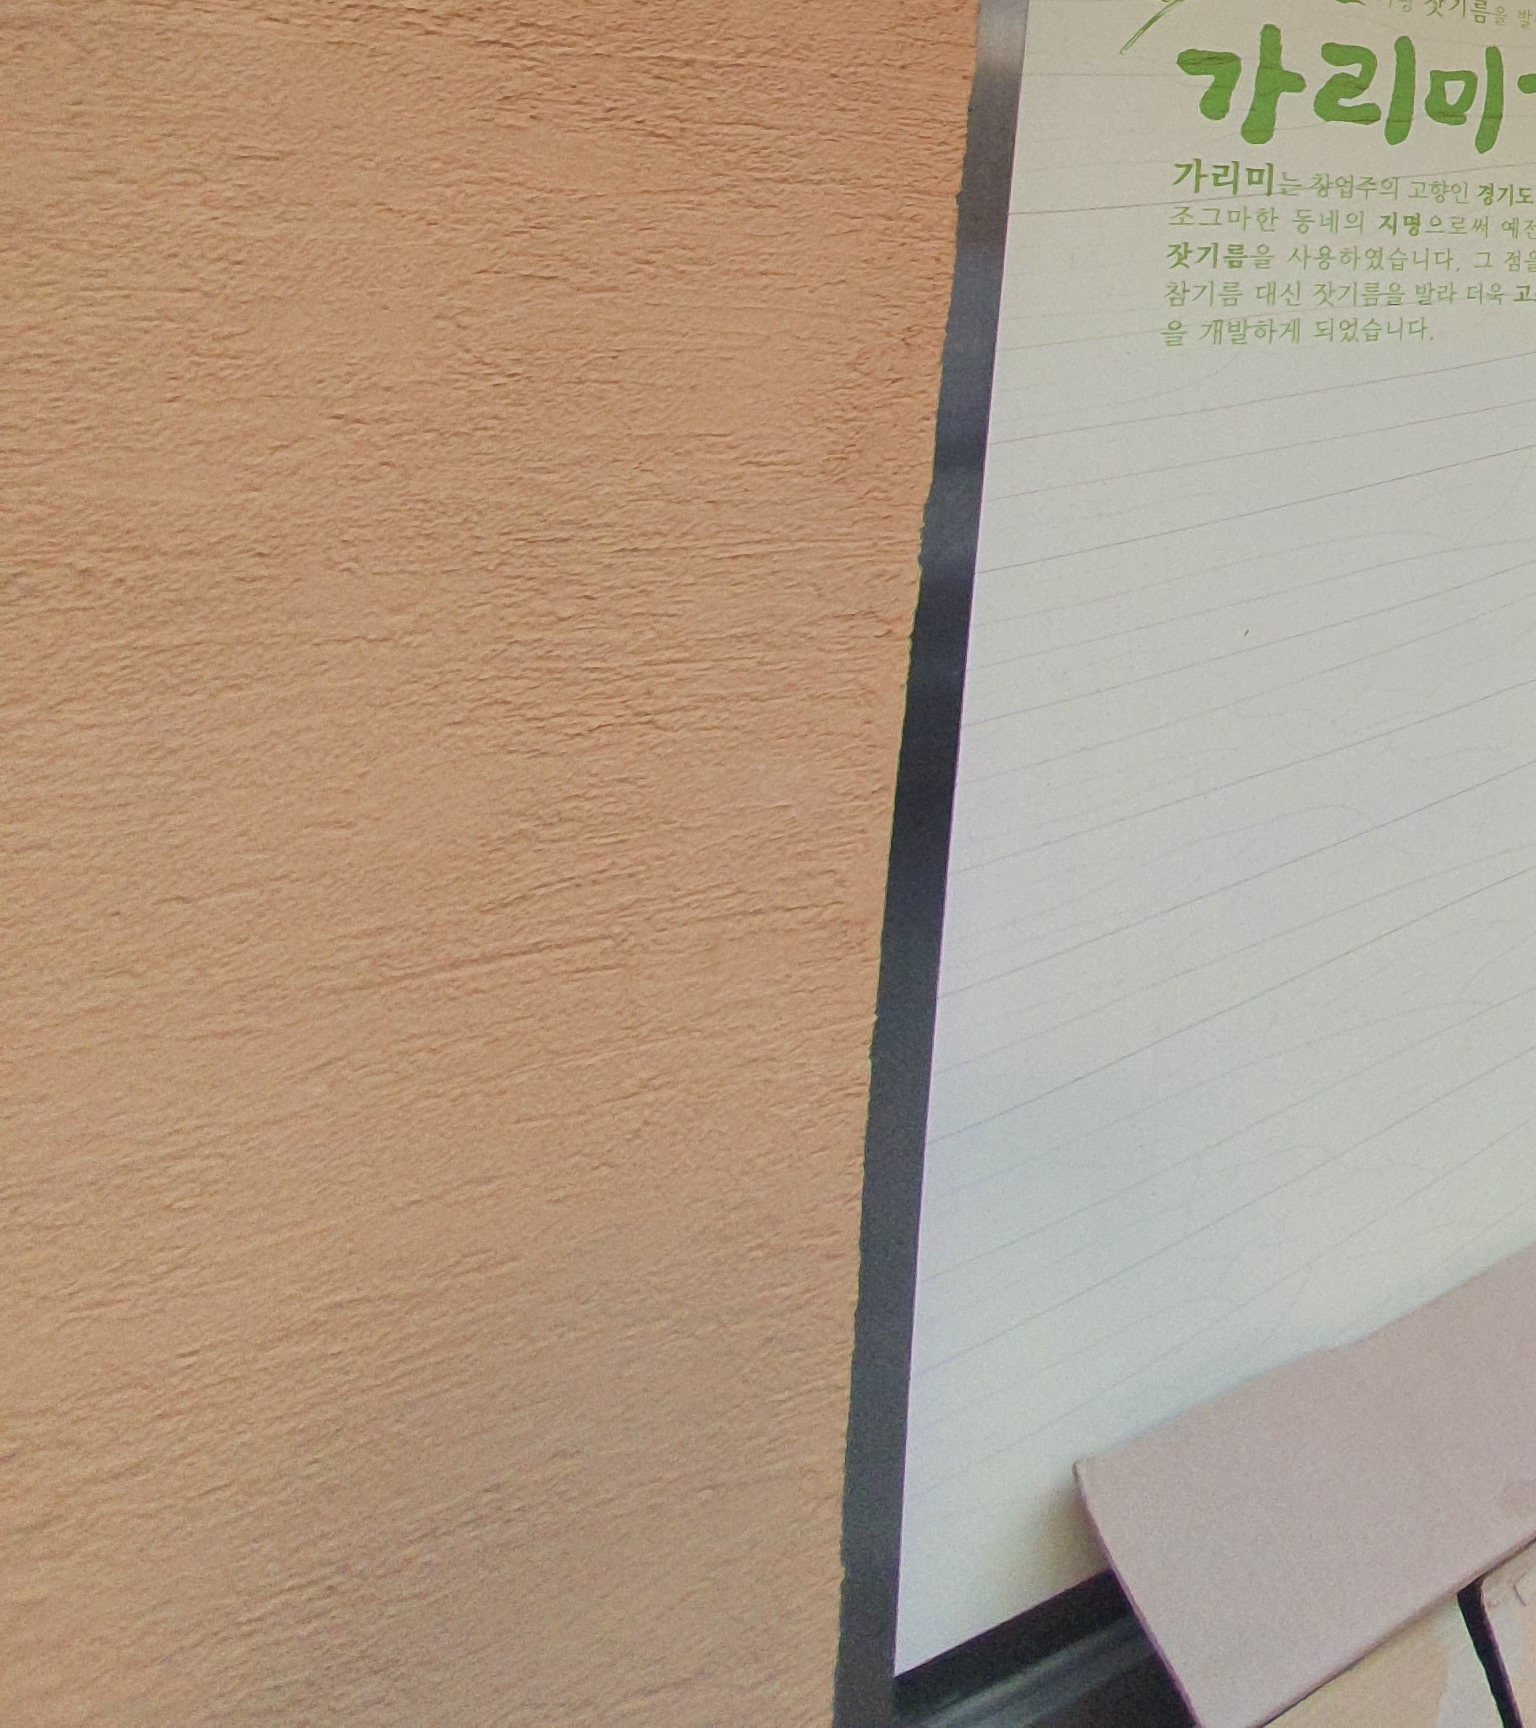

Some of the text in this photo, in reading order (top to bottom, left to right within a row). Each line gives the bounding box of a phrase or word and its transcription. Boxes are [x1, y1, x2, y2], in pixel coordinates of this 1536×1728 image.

[1172, 158, 1302, 197] 가리미는
[1310, 172, 1400, 200] 창업주의
[1407, 180, 1469, 206] 고향인
[1477, 182, 1534, 207] 경기도
[1168, 205, 1279, 233] 조그마한
[1291, 208, 1365, 235] 동네의
[1378, 211, 1490, 239] 지명으로써
[1165, 241, 1276, 270] 잣기름을
[1287, 243, 1461, 273] 사용하였습니다.
[1473, 250, 1494, 269] 그
[1164, 280, 1245, 308] 참기름
[1255, 280, 1303, 307] 대신
[1312, 281, 1406, 308] 잣기름을
[1414, 281, 1458, 306] 발라
[1465, 283, 1505, 305] 더욱
[1160, 316, 1435, 347] 을 개발하게 되었습니다.
